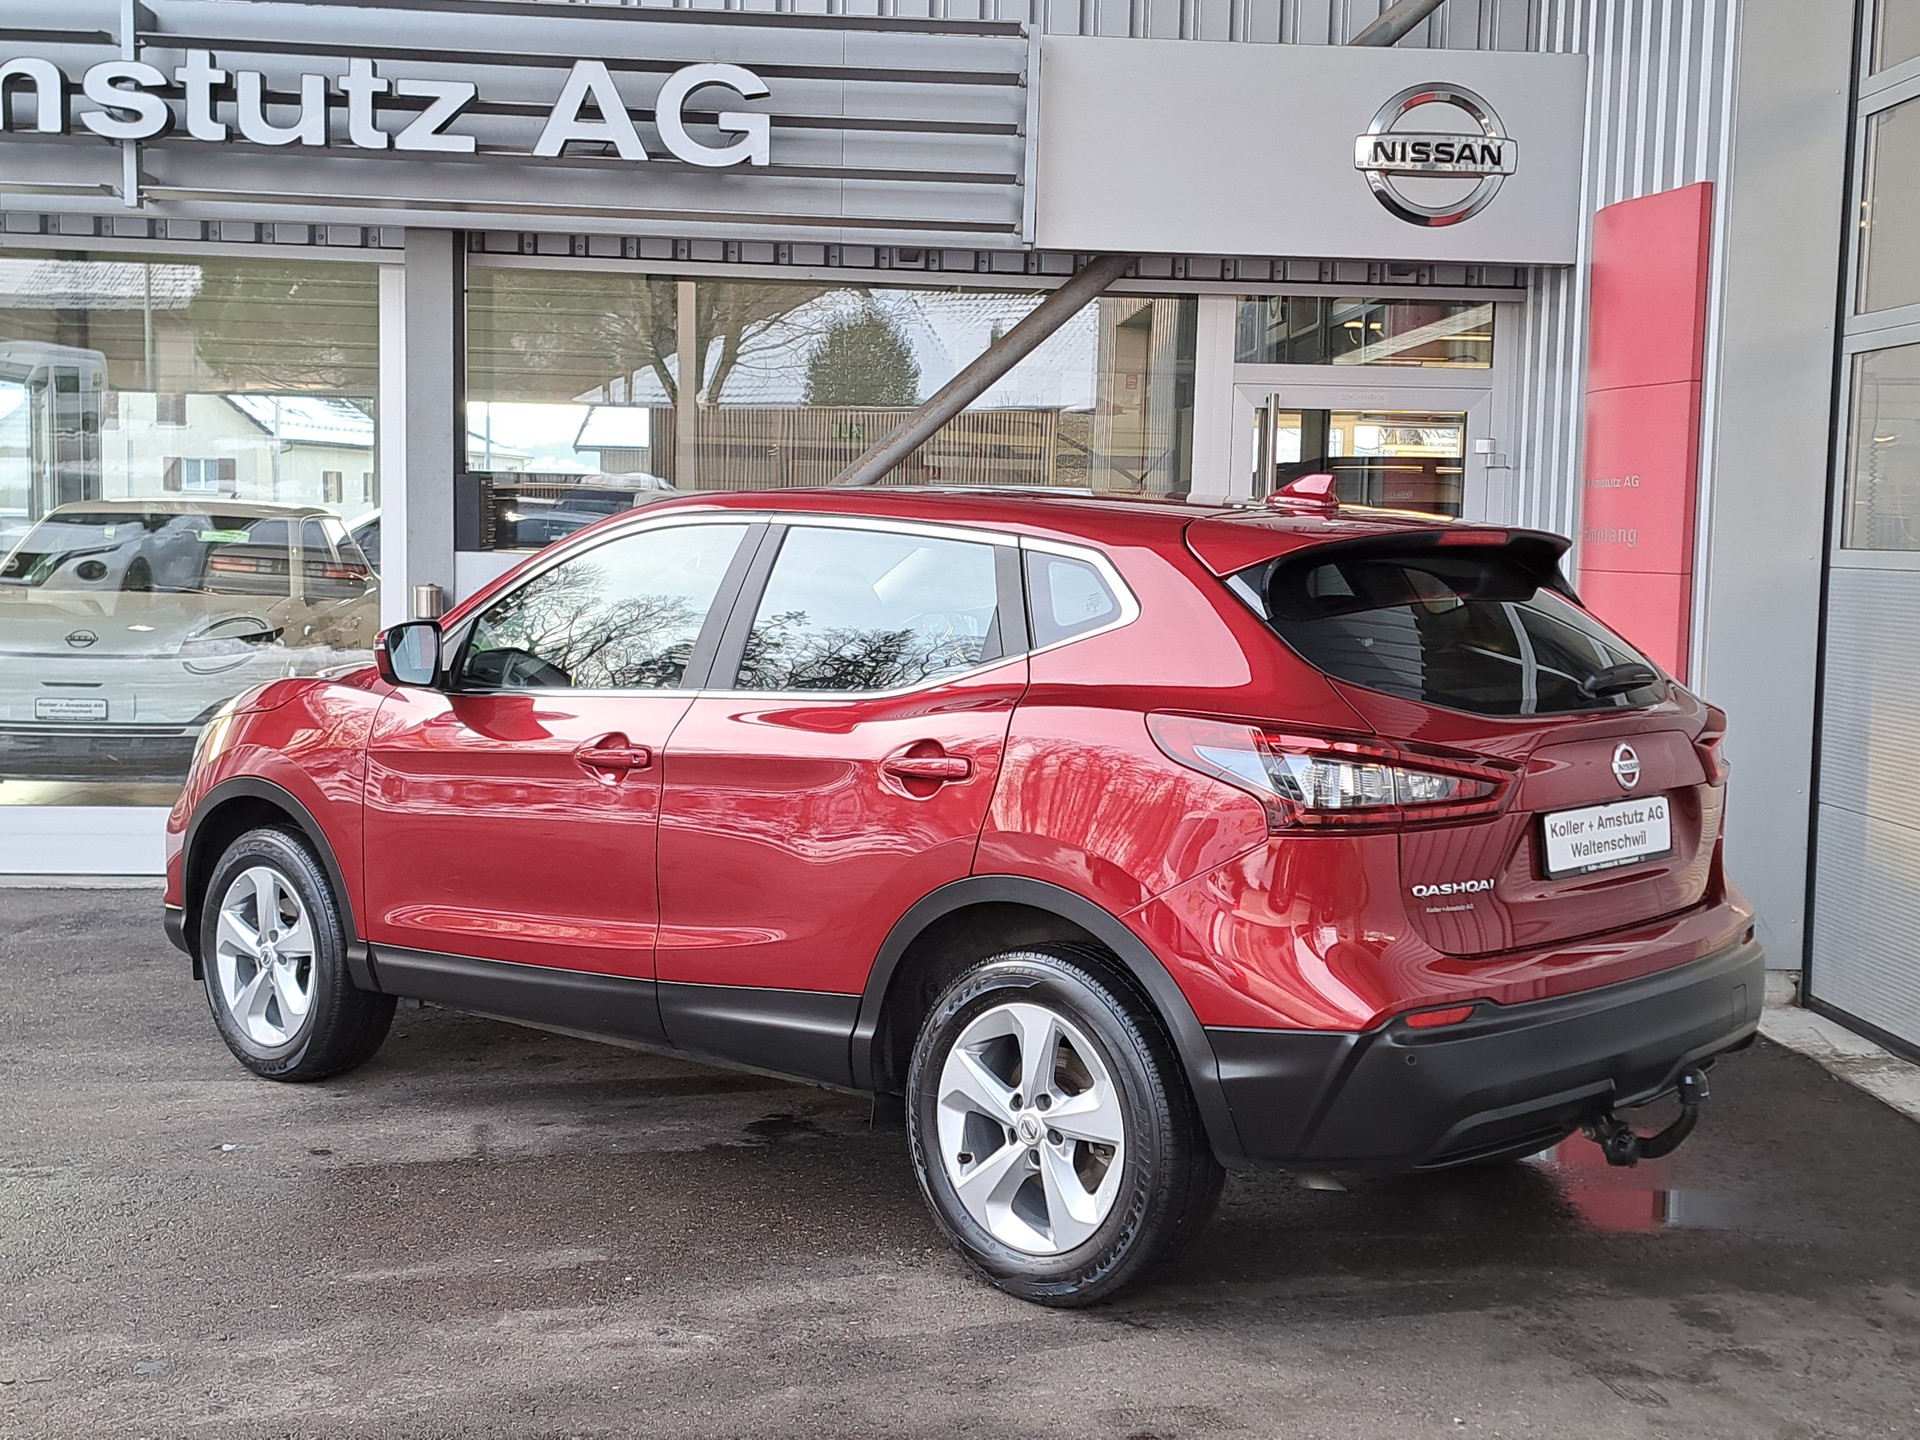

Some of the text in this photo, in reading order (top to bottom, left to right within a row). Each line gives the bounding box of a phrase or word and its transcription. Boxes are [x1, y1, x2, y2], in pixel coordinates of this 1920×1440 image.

[531, 60, 771, 167] AG
[1372, 141, 1502, 166] NISSAN
[1624, 475, 1640, 487] AG
[1550, 805, 1664, 839] Koller + Amstutz AG
[1570, 830, 1647, 859] Waltenschwil
[1411, 878, 1495, 899] QASHQAI
